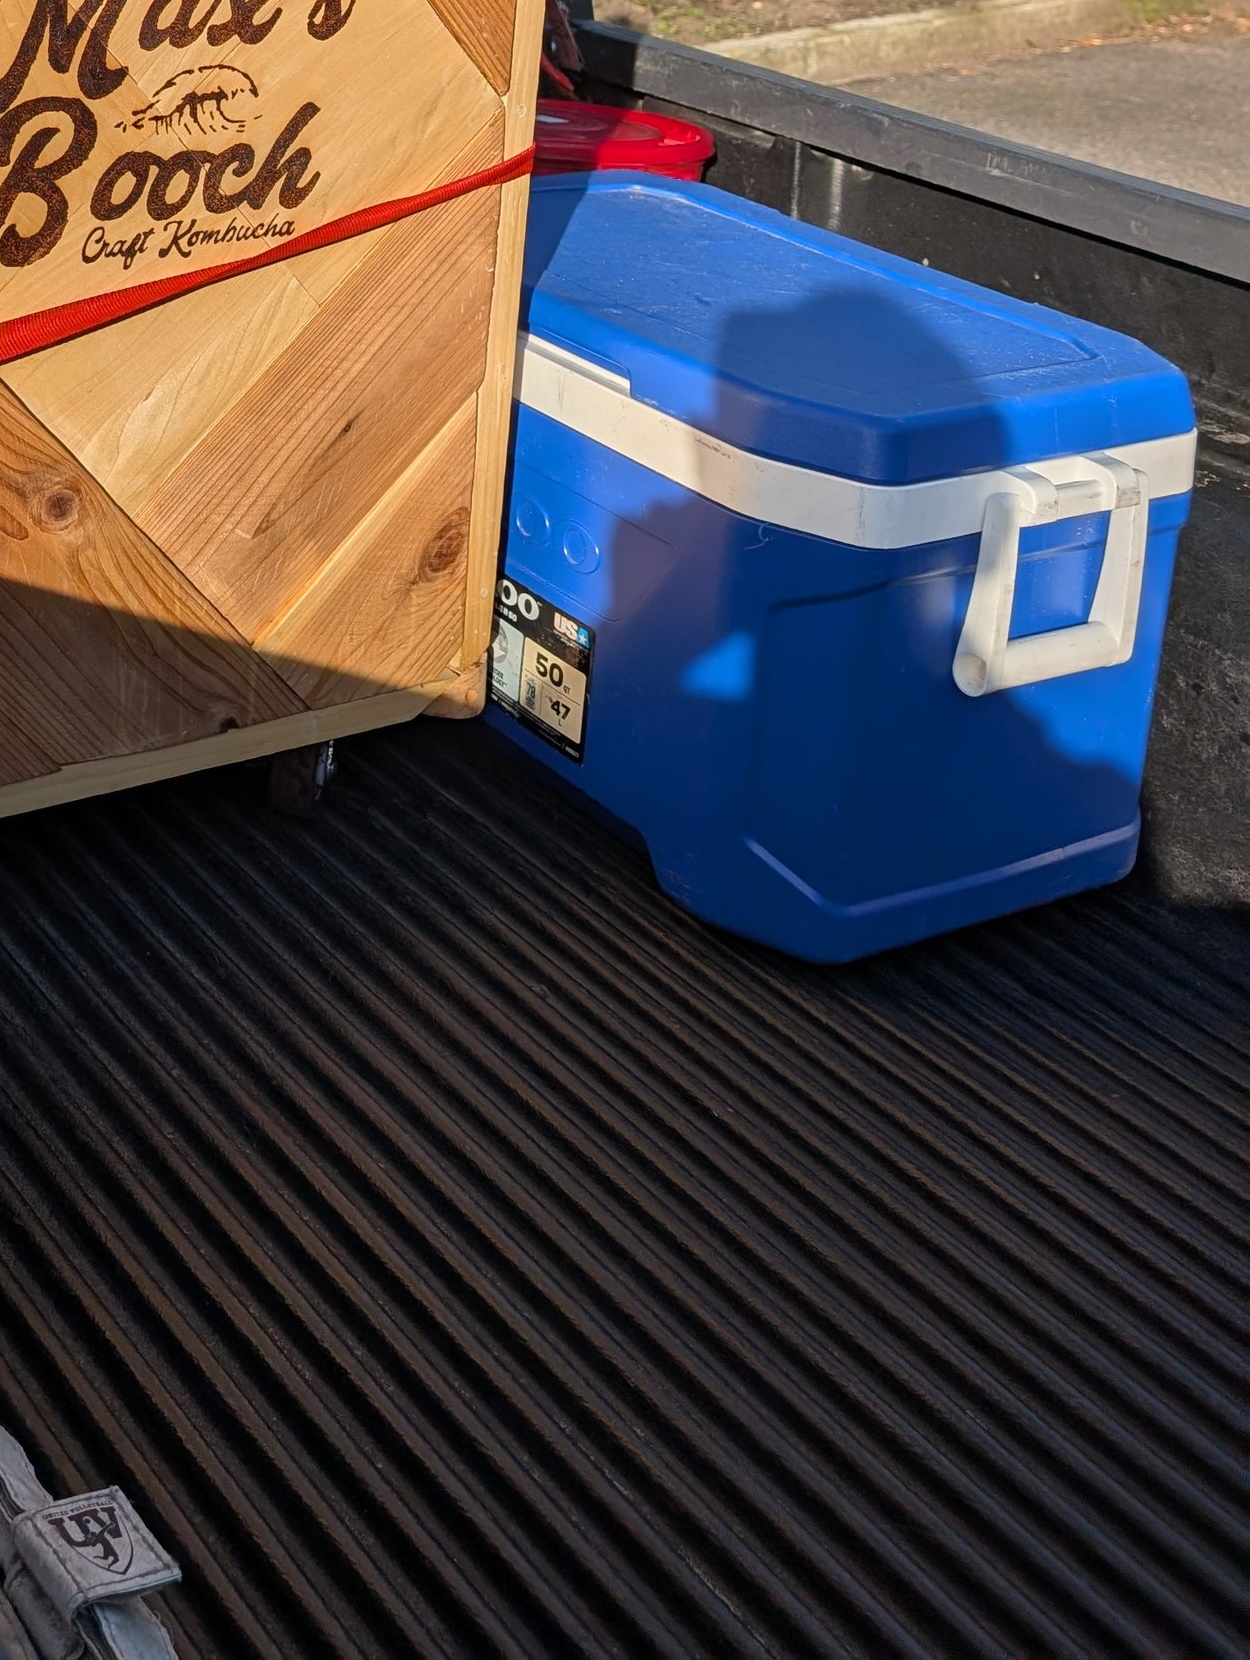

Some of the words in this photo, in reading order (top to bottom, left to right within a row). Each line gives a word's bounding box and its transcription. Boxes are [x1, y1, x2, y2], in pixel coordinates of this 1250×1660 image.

[81, 226, 155, 270] Craft
[158, 213, 295, 258] Kombucha
[535, 651, 564, 687] 50
[550, 700, 571, 720] 47
